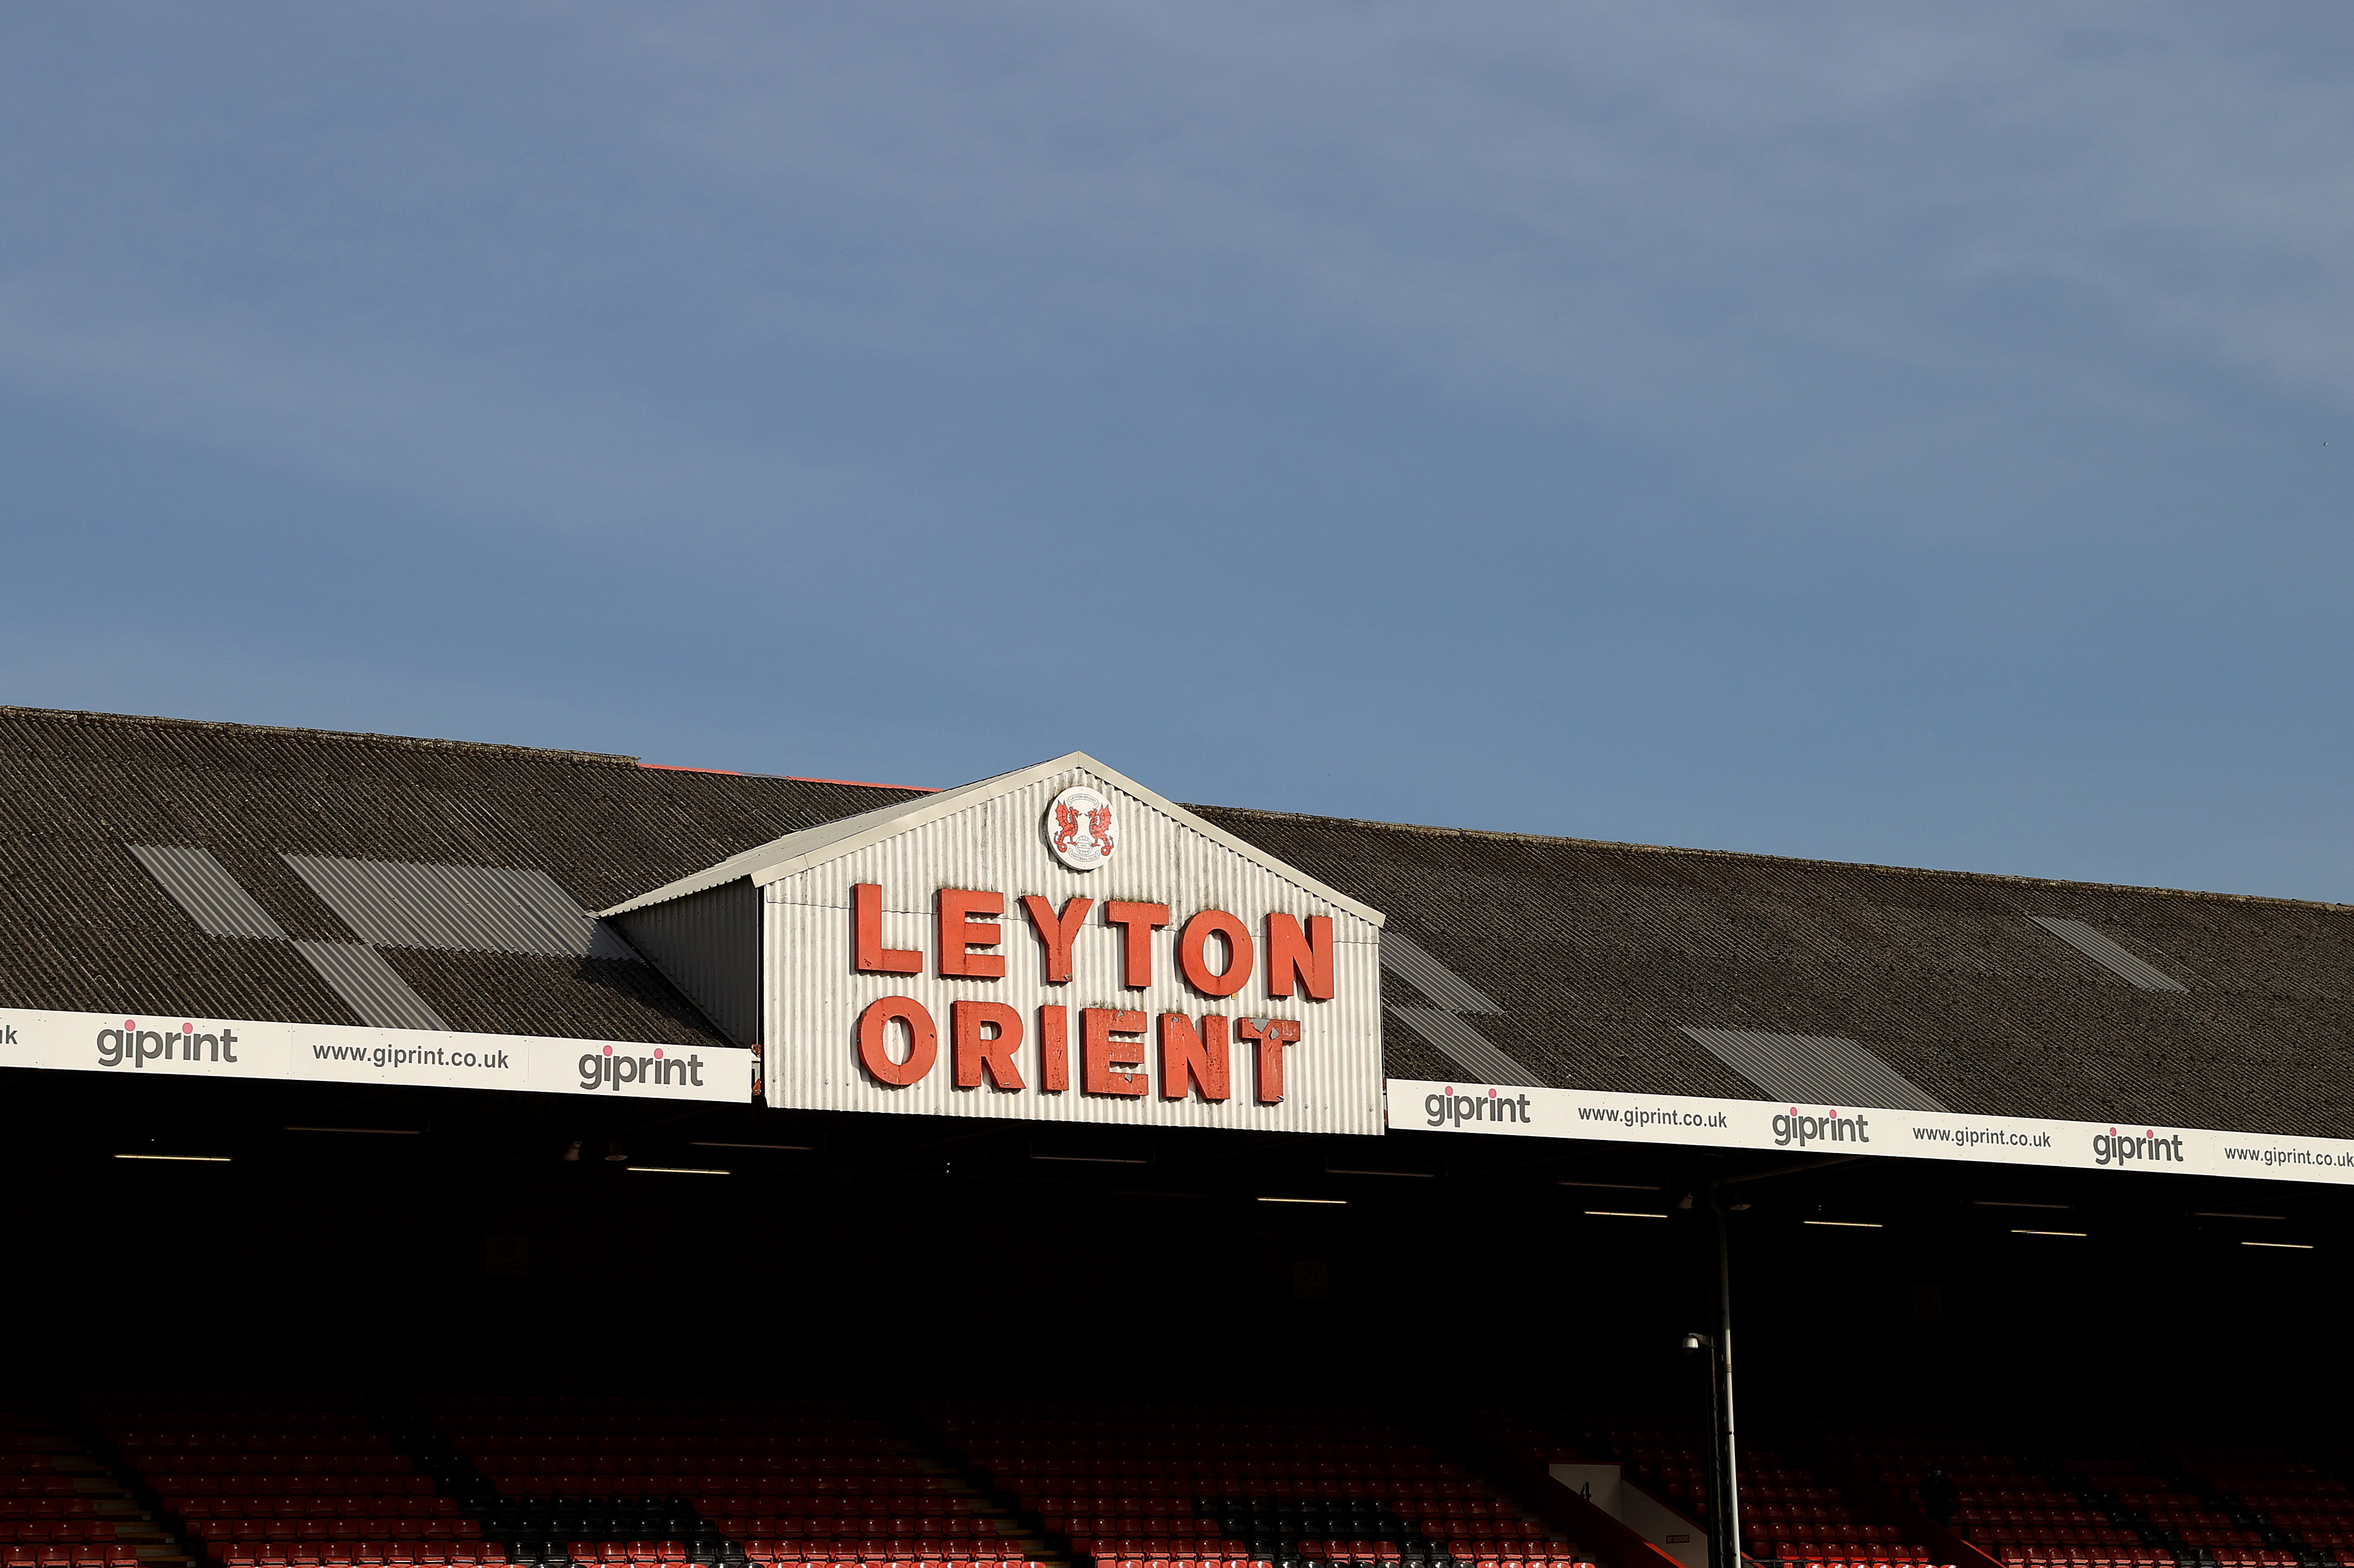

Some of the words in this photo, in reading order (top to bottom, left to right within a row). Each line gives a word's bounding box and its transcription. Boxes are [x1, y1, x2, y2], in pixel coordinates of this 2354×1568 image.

[1071, 853, 1088, 861] FOOTBALL
[854, 883, 1334, 1001] LEYTON
[96, 1019, 238, 1068] giprint
[312, 1044, 509, 1069] www.giprint.co.uk
[858, 996, 1300, 1103] ORIENT
[578, 1045, 704, 1091] giprint
[1425, 1085, 1531, 1127] giprint
[1578, 1106, 1727, 1129] www.giprint.co.uk
[1772, 1106, 1870, 1147] giprint
[1912, 1126, 2052, 1148] www.giprint.co.uk
[2093, 1126, 2184, 1166] giprint
[2224, 1146, 2354, 1168] www.giprint.co.uk
[1580, 1482, 1591, 1502] 4
